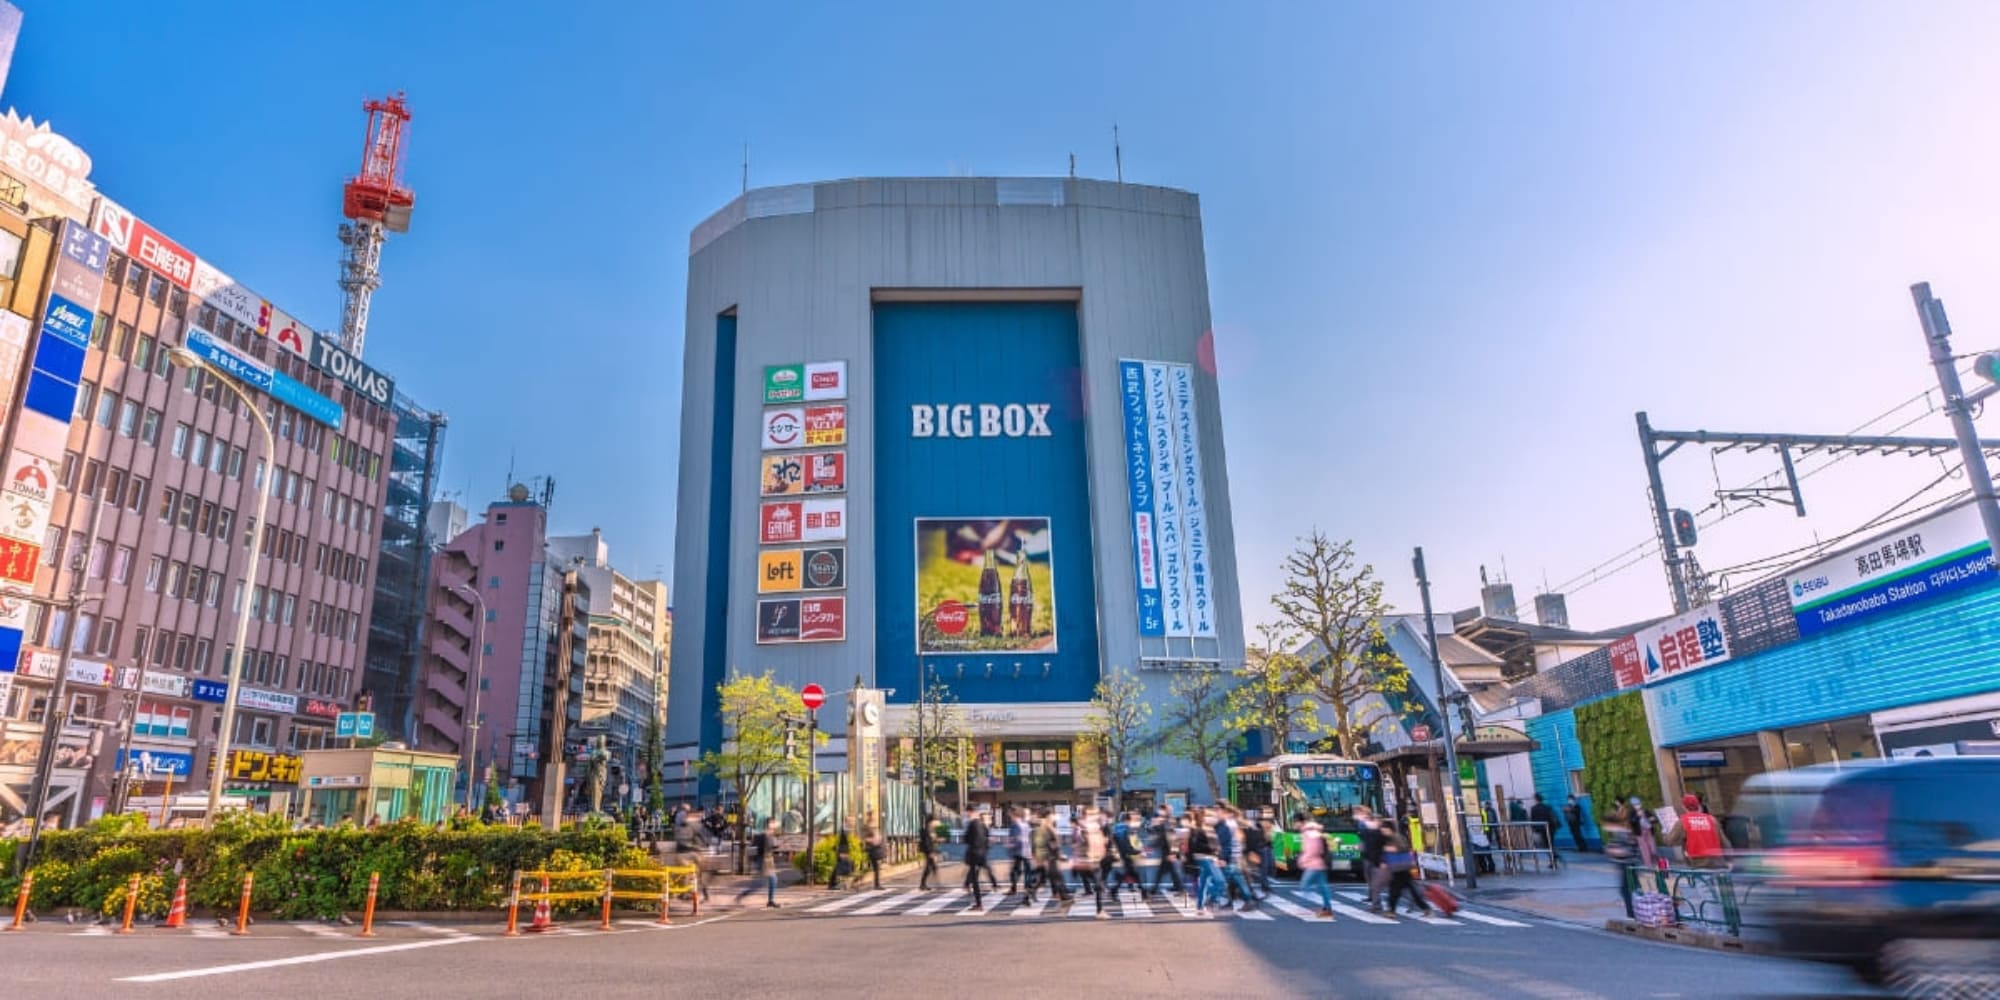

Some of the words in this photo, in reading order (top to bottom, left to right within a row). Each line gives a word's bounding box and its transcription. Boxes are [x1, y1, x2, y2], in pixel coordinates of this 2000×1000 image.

[138, 234, 192, 284] 日能研
[319, 340, 388, 402] TOMAS
[768, 424, 801, 434] スシロー
[911, 403, 974, 438] BIG
[979, 403, 1052, 438] BOX
[12, 481, 46, 499] TOMAS
[768, 561, 794, 580] Loft
[1855, 533, 1925, 577] 高田馬場駅
[1803, 576, 1830, 593] SEIBU
[1818, 593, 1888, 624] Takadanobaba
[1888, 580, 1928, 602] Station
